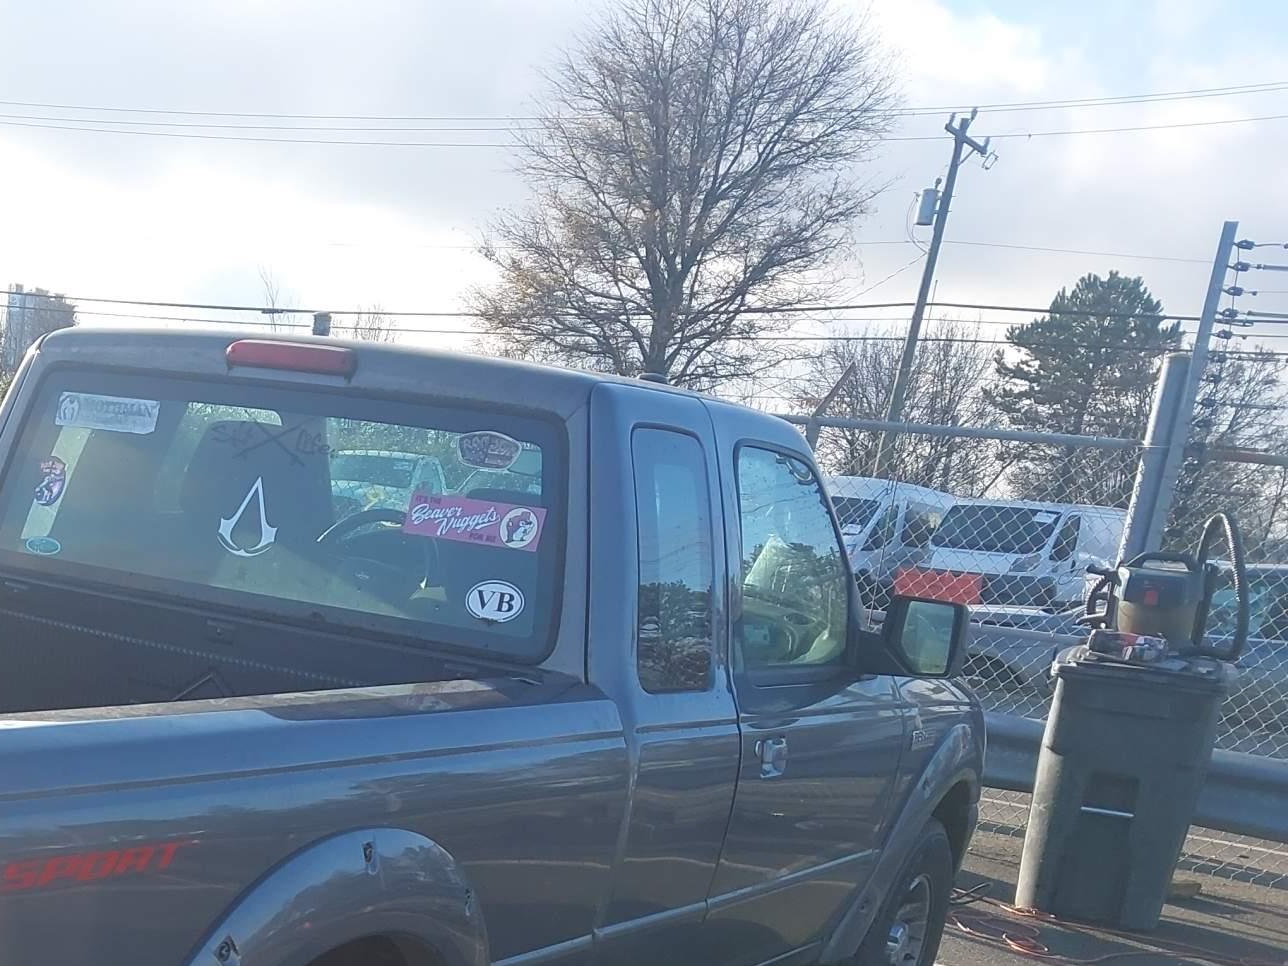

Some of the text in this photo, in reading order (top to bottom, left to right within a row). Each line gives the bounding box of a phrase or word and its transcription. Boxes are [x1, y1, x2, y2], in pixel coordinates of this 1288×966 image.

[412, 503, 462, 525] Beaver
[434, 506, 500, 536] Nuggets
[476, 589, 515, 612] VB
[0, 842, 185, 893] SPORT
